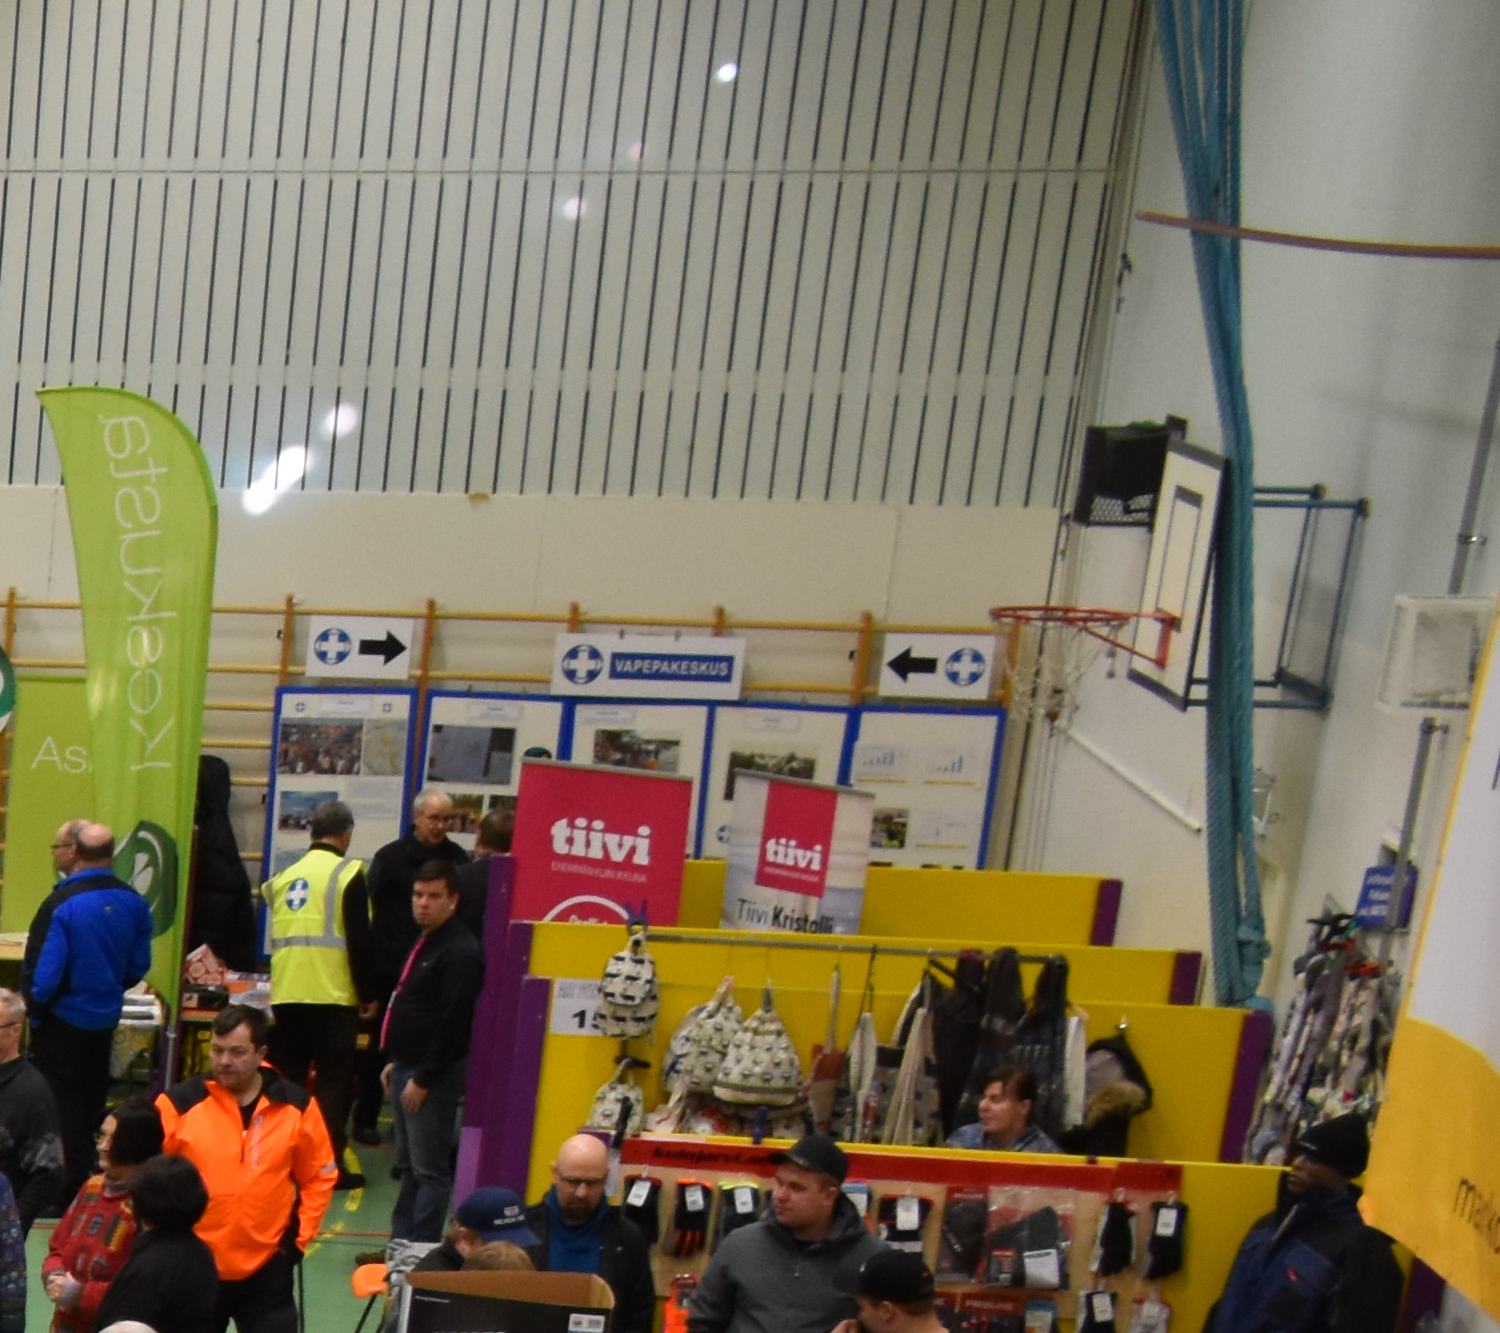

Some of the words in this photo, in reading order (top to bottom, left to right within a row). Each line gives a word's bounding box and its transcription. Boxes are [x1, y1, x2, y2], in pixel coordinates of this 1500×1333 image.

[615, 657, 730, 677] VAPEPAKESKUS
[31, 736, 92, 773] As
[551, 816, 651, 866] tiivi
[765, 837, 823, 871] tiivi
